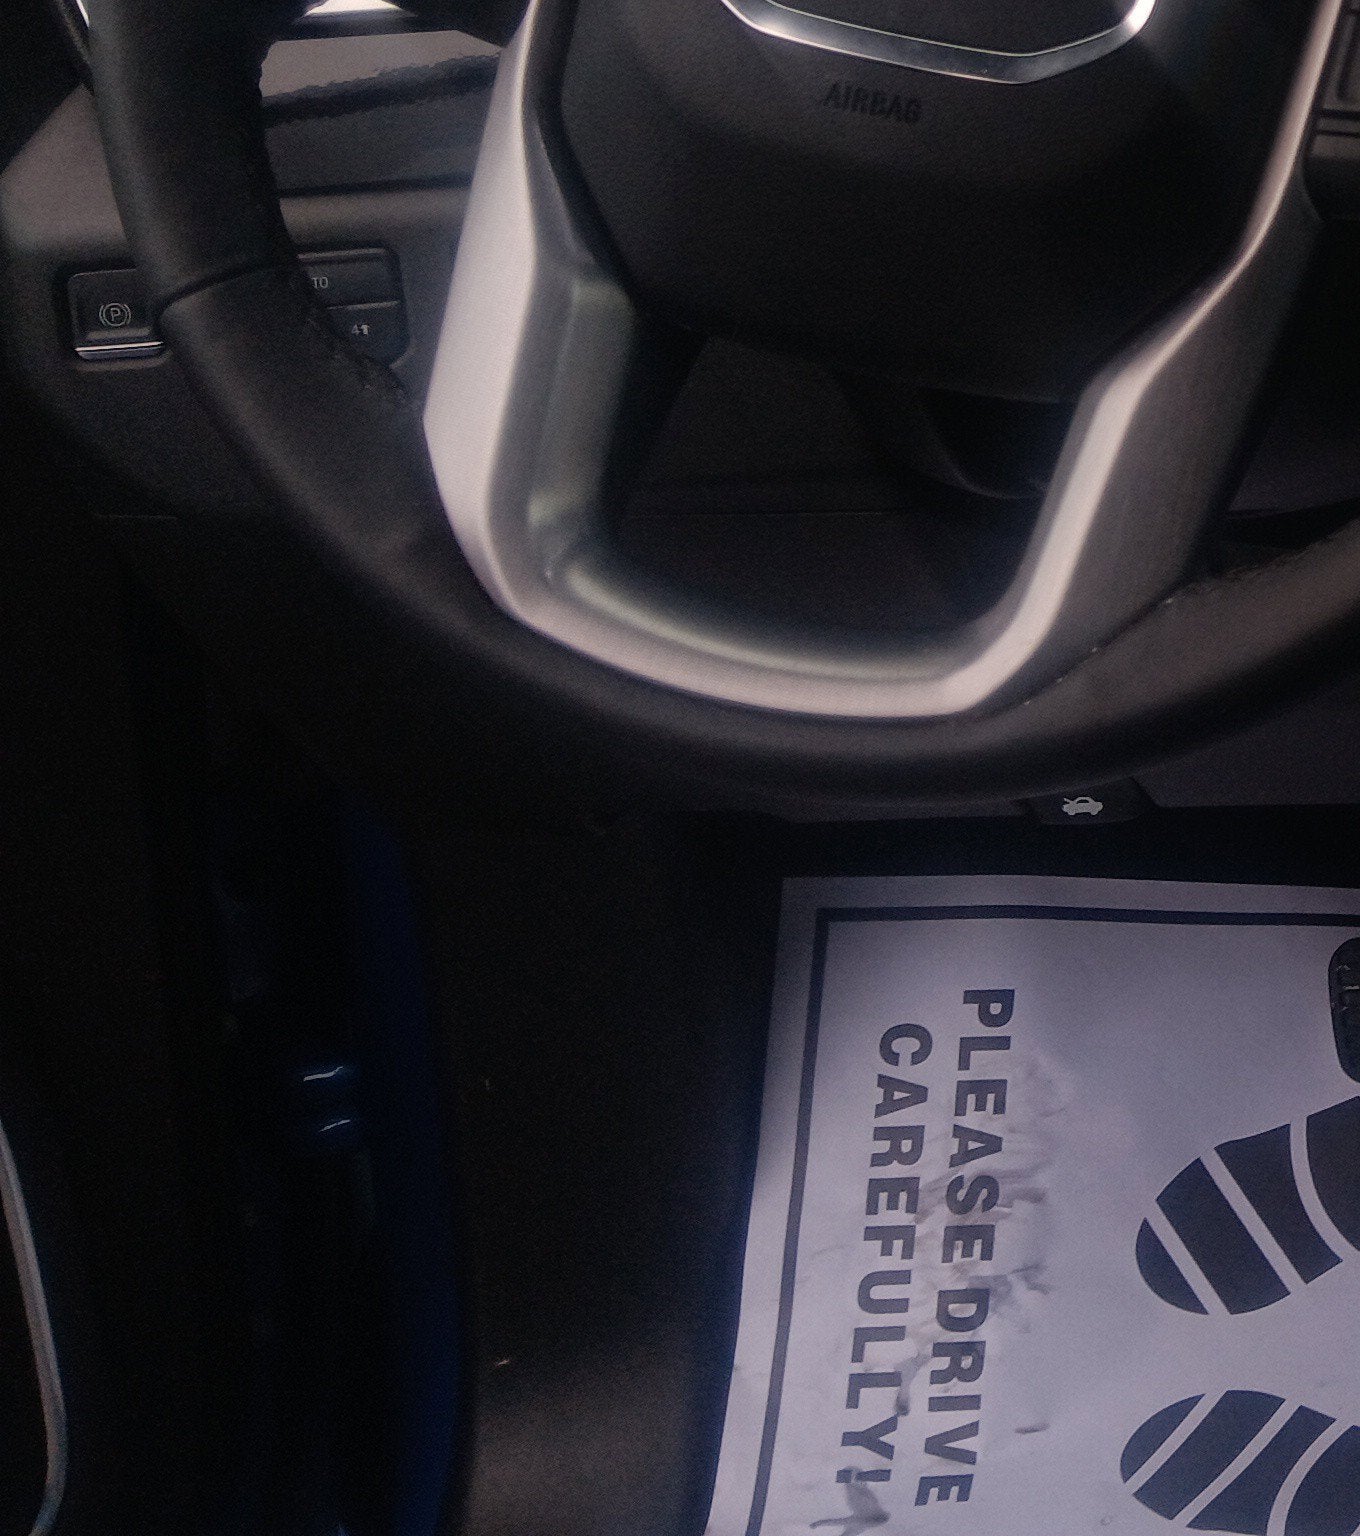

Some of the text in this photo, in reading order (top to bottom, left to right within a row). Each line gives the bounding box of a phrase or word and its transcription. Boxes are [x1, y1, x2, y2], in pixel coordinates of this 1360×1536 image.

[823, 83, 922, 124] AIRBAG
[836, 1022, 933, 1485] CAREFULLY!
[914, 988, 1015, 1507] PLEASE DRIVE
